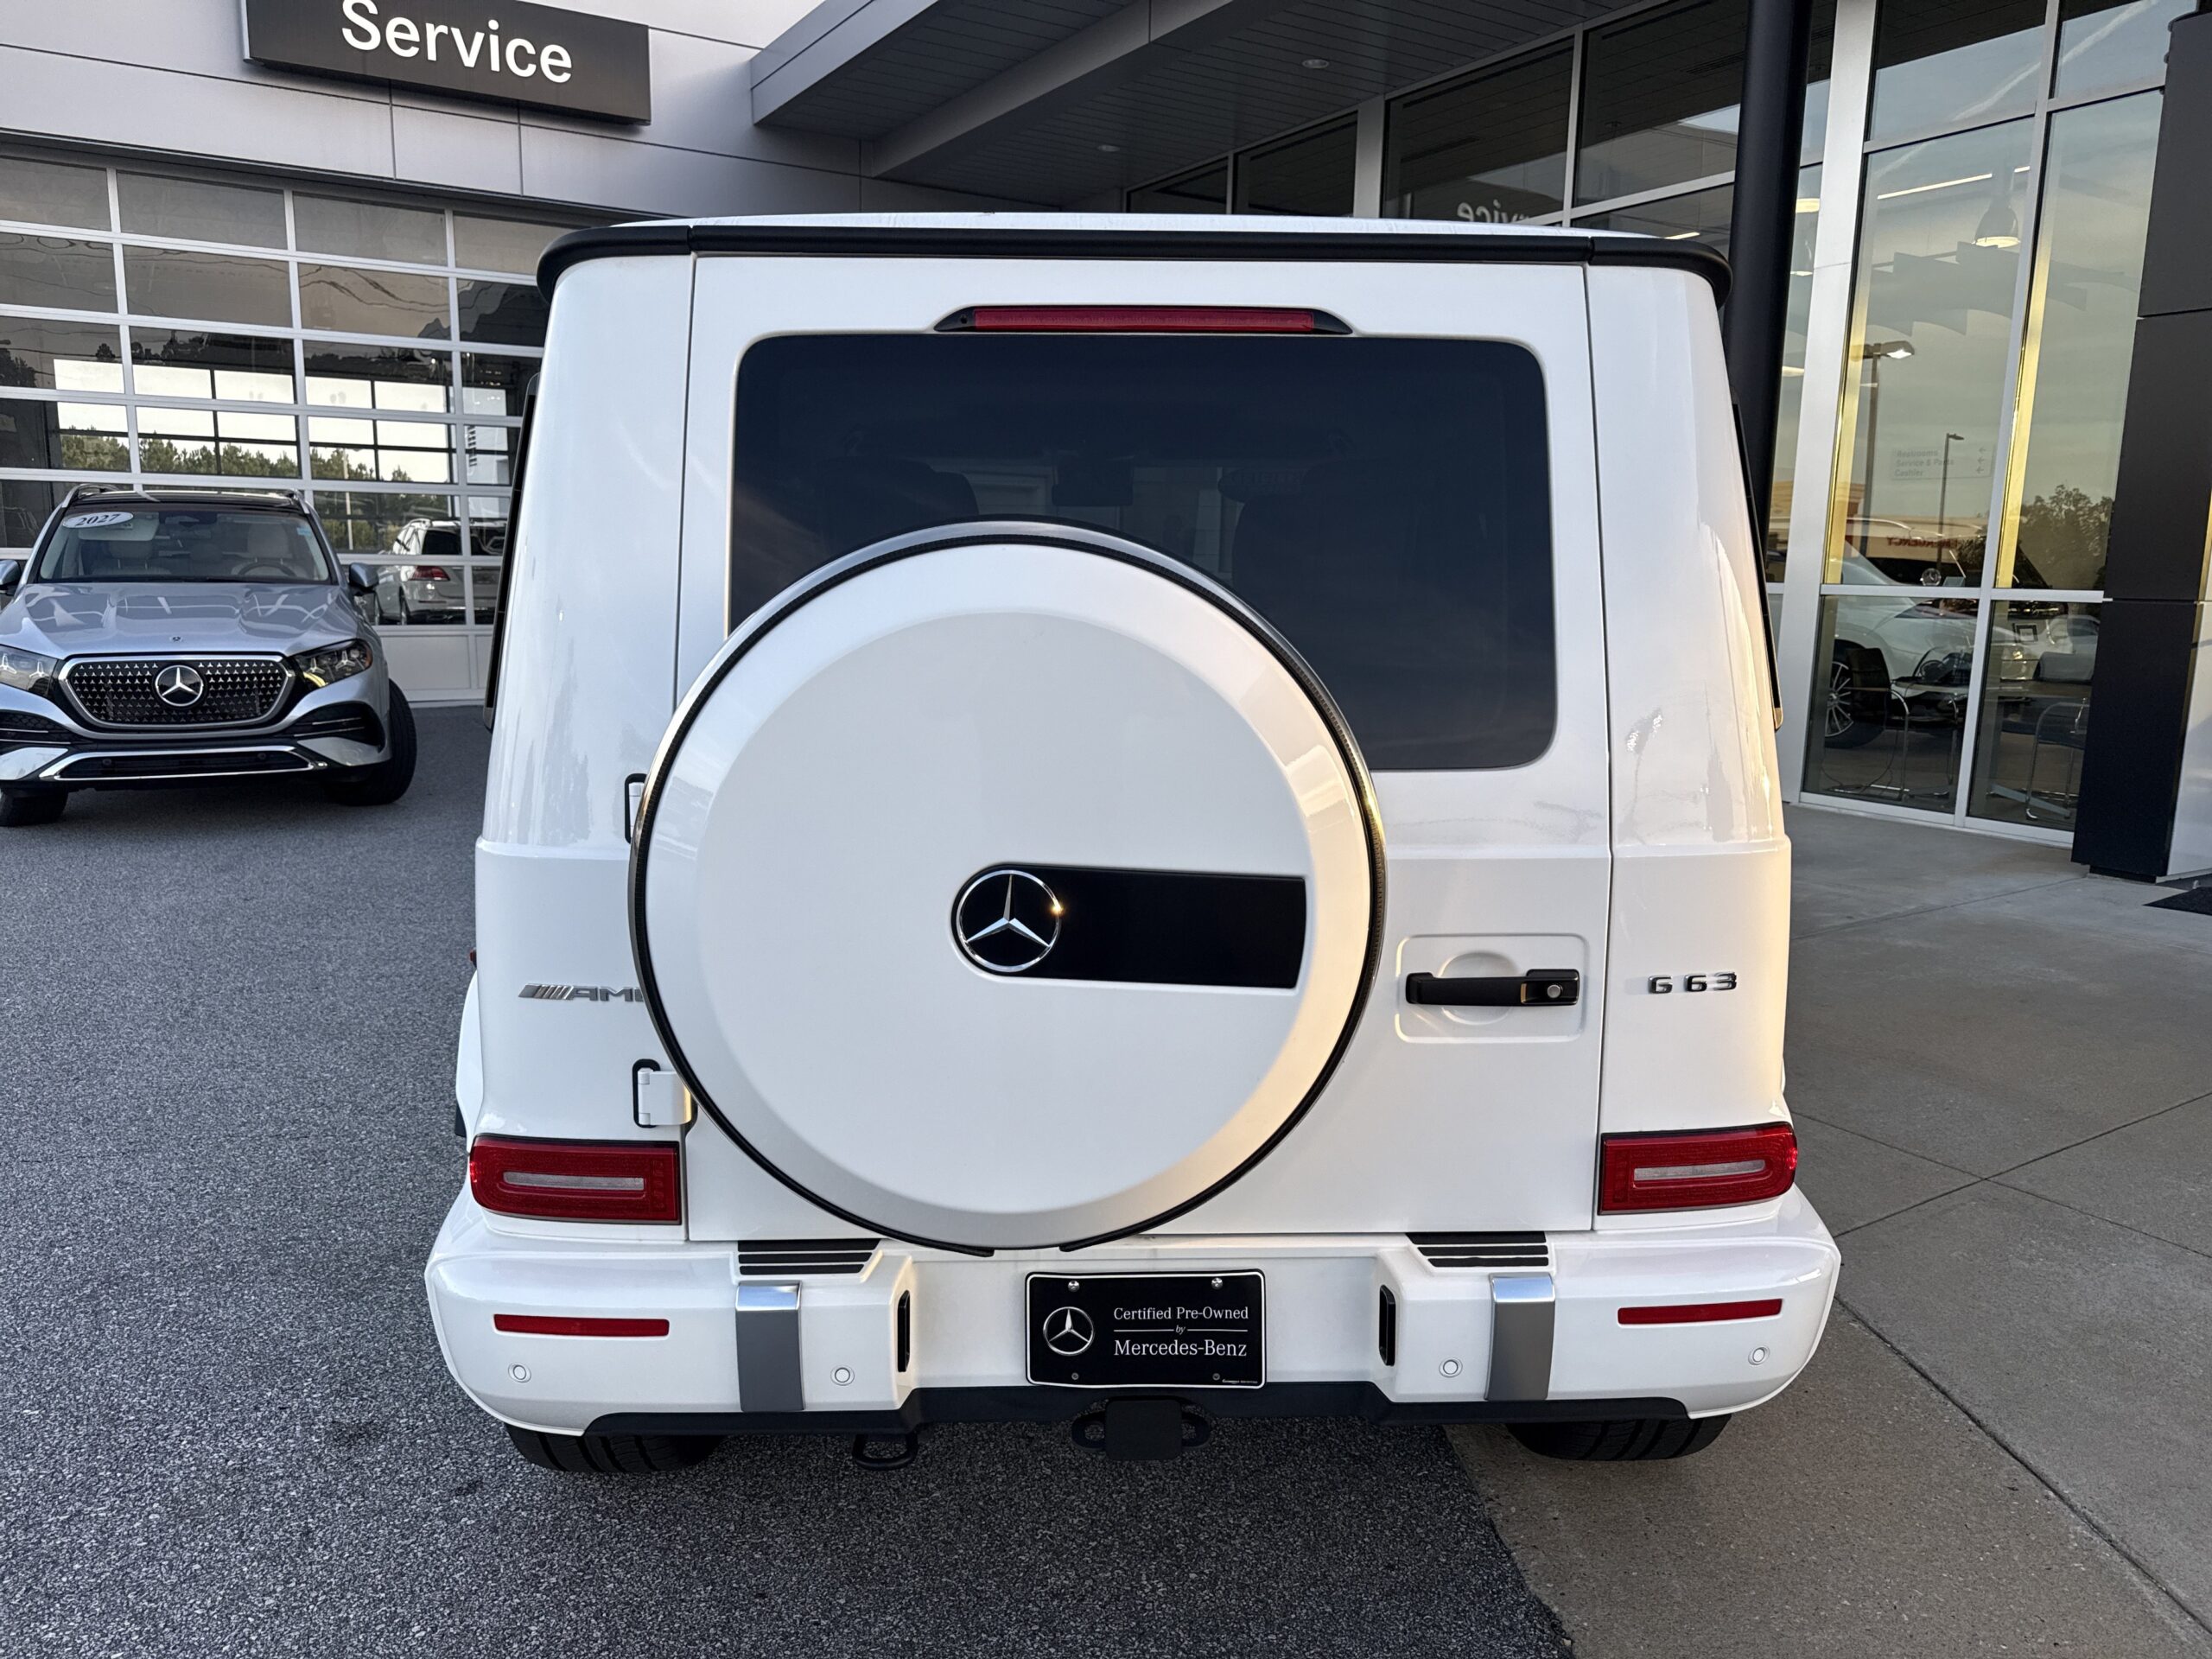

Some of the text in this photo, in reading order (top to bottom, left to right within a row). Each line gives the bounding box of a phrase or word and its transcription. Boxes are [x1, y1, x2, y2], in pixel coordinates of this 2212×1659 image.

[342, 0, 572, 84] Service
[74, 514, 120, 526] 2027
[1648, 972, 1737, 994] G 63
[563, 985, 644, 1002] AM
[1113, 1306, 1249, 1320] Certified Pre-Owned
[1175, 1325, 1186, 1335] by
[1114, 1339, 1247, 1357] Mercedes-Benz
